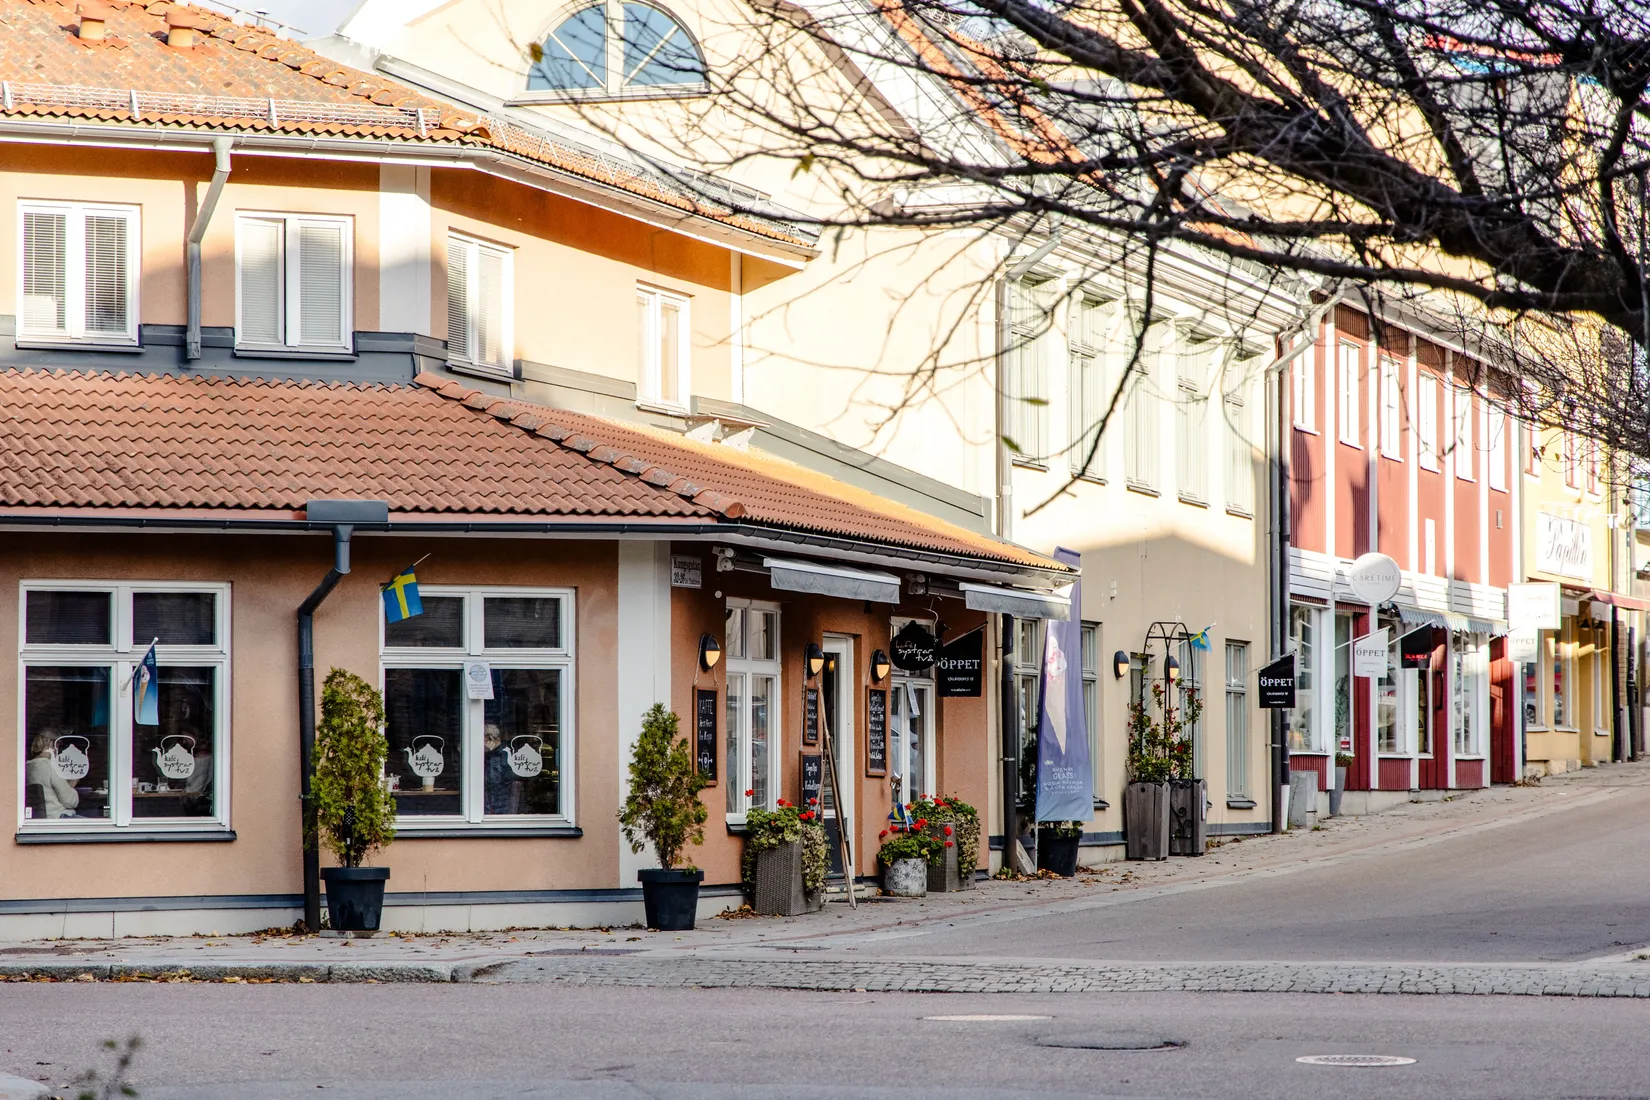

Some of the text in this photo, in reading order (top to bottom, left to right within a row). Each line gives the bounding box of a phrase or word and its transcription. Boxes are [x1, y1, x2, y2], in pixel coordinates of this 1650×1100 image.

[898, 644, 933, 659] systrar
[1356, 648, 1385, 657] ÖPPET
[940, 657, 980, 669] ÖPPET
[1260, 677, 1293, 686] ÖPPET
[58, 760, 87, 772] systrar
[164, 759, 193, 770] systrar
[414, 758, 443, 770] systrar
[514, 758, 540, 770] systrar
